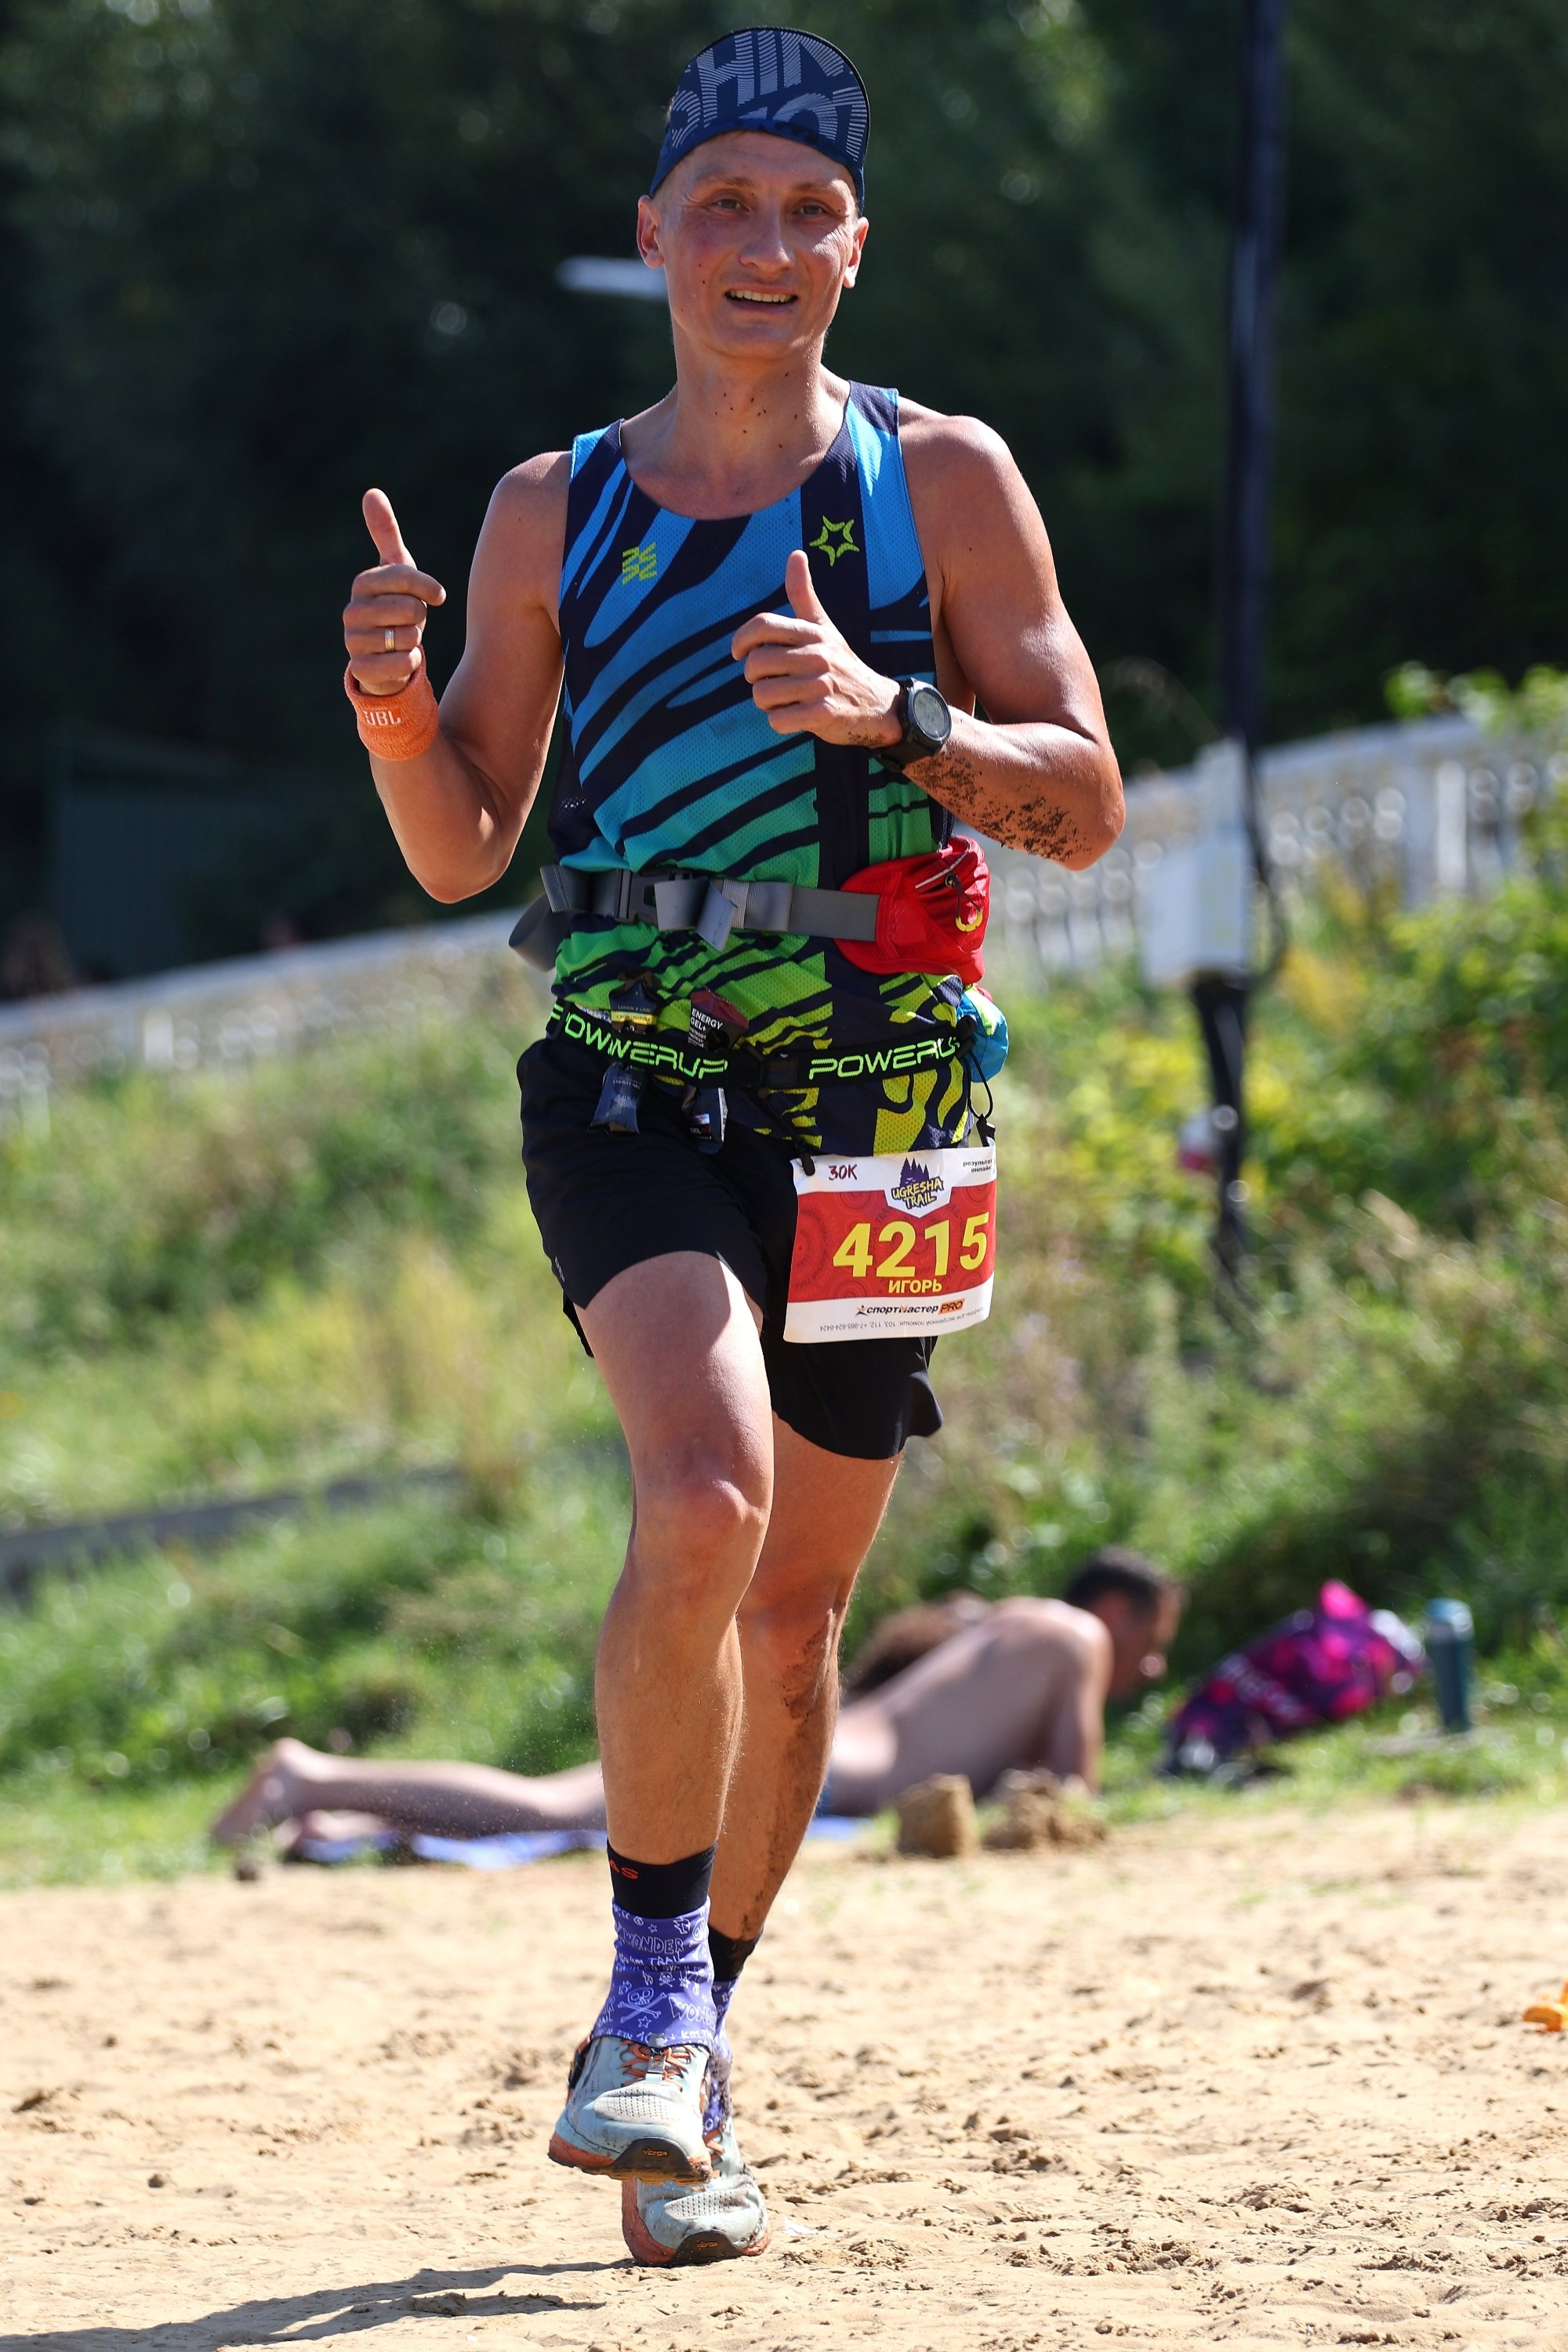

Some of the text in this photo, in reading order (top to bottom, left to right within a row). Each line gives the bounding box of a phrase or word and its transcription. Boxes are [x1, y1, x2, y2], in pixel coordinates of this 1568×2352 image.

[363, 710, 401, 727] JBL
[691, 1007, 723, 1030] ENERGY
[828, 1164, 858, 1181] 30K
[891, 1177, 944, 1201] UGRESHA
[904, 1193, 936, 1210] TRAIL
[833, 1211, 989, 1278] 4215
[888, 1278, 942, 1294] ИГОРЬ
[940, 1300, 964, 1313] PRO
[623, 1927, 684, 1955] WONDER
[648, 1950, 685, 1966] TRAIL
[643, 2147, 668, 2157] vibram
